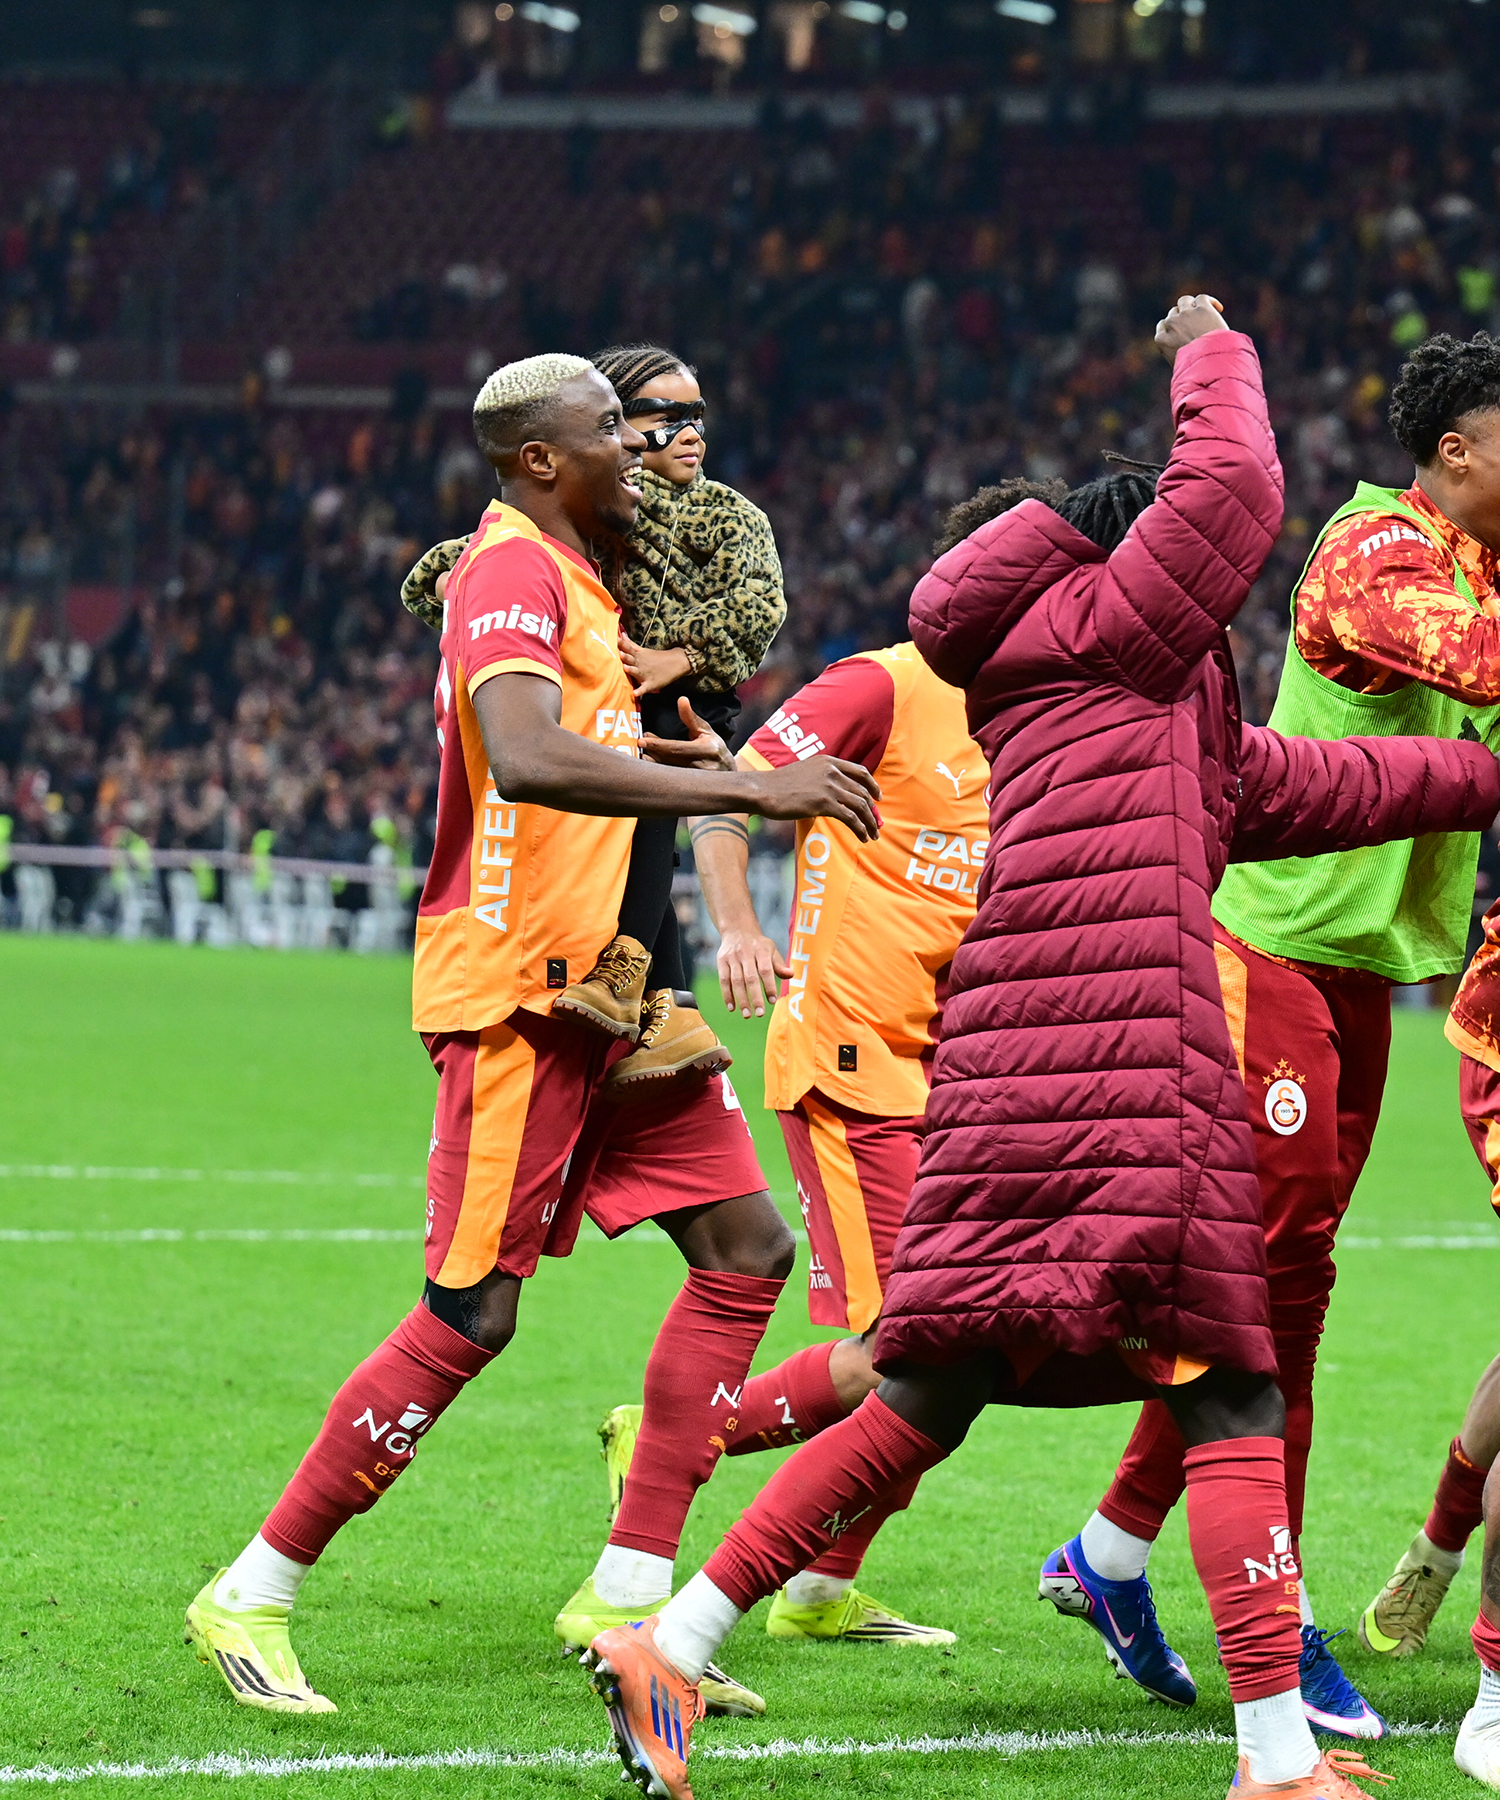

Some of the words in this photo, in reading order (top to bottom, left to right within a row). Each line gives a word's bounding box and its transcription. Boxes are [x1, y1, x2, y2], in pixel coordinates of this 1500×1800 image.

[468, 604, 557, 645] misli
[905, 858, 981, 894] HOL
[788, 832, 831, 1023] ALFEMO
